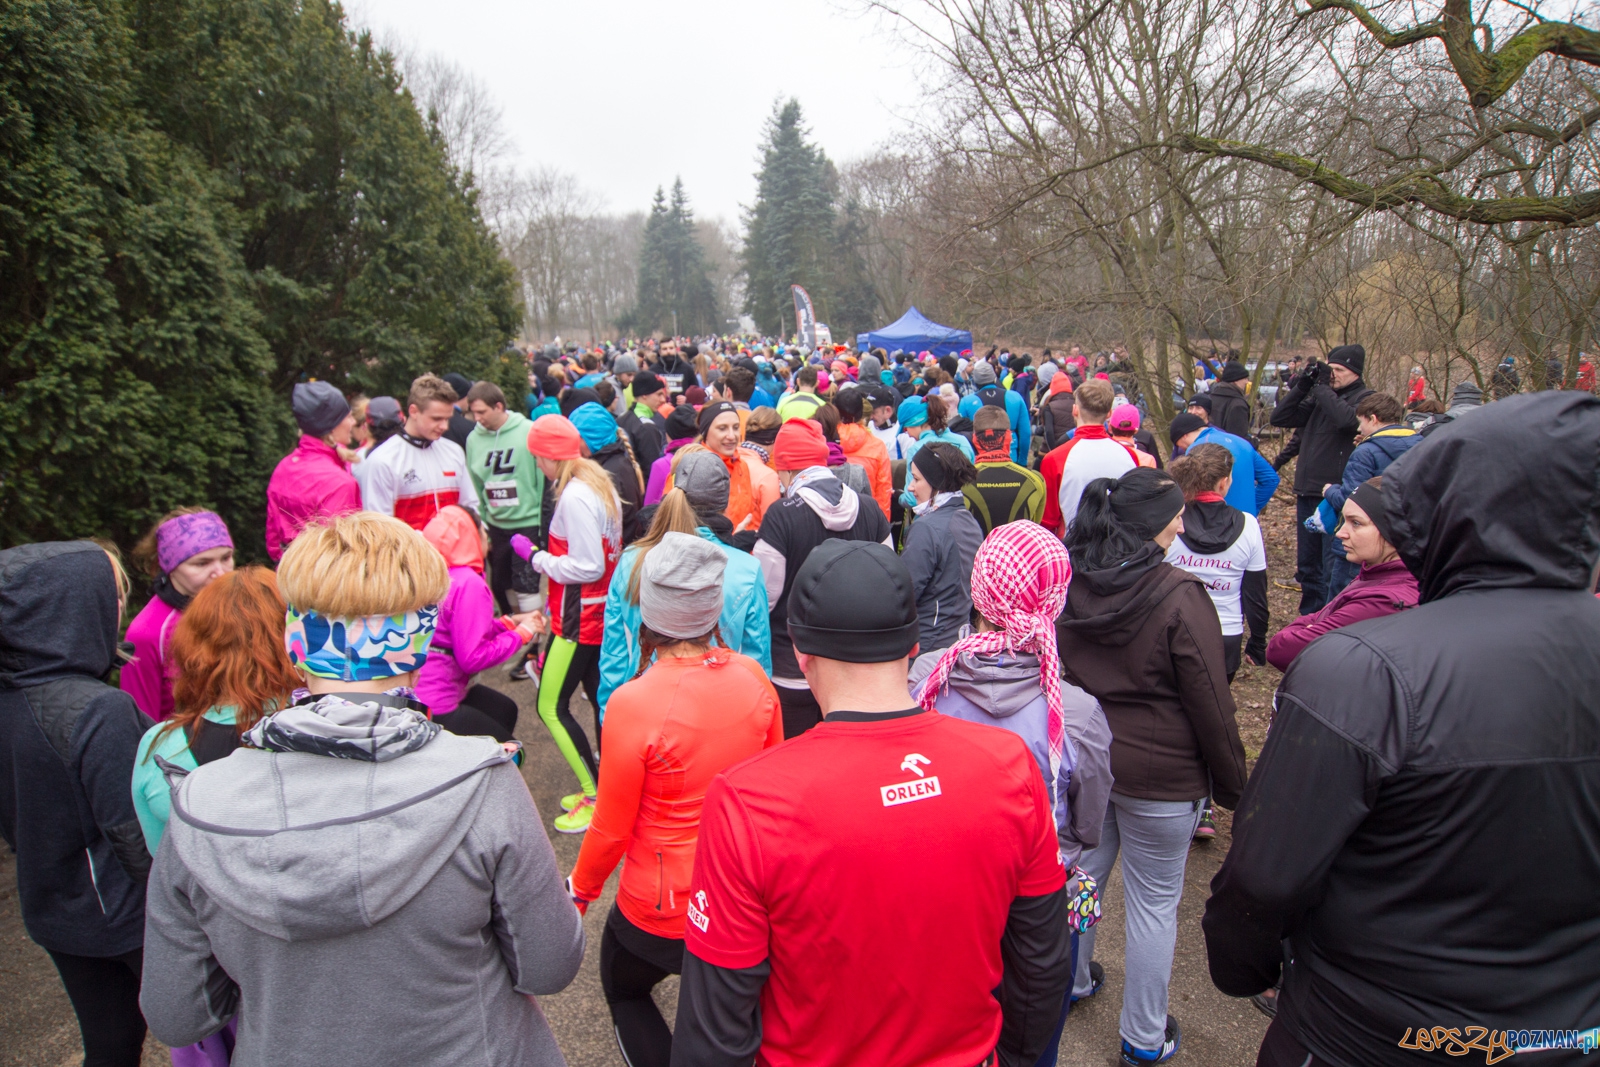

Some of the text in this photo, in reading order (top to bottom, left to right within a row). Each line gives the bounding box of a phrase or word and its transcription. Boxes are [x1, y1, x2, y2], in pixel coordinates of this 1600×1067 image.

[491, 489, 508, 499] 792
[1173, 554, 1232, 569] Mama
[886, 780, 936, 802] ORLEN
